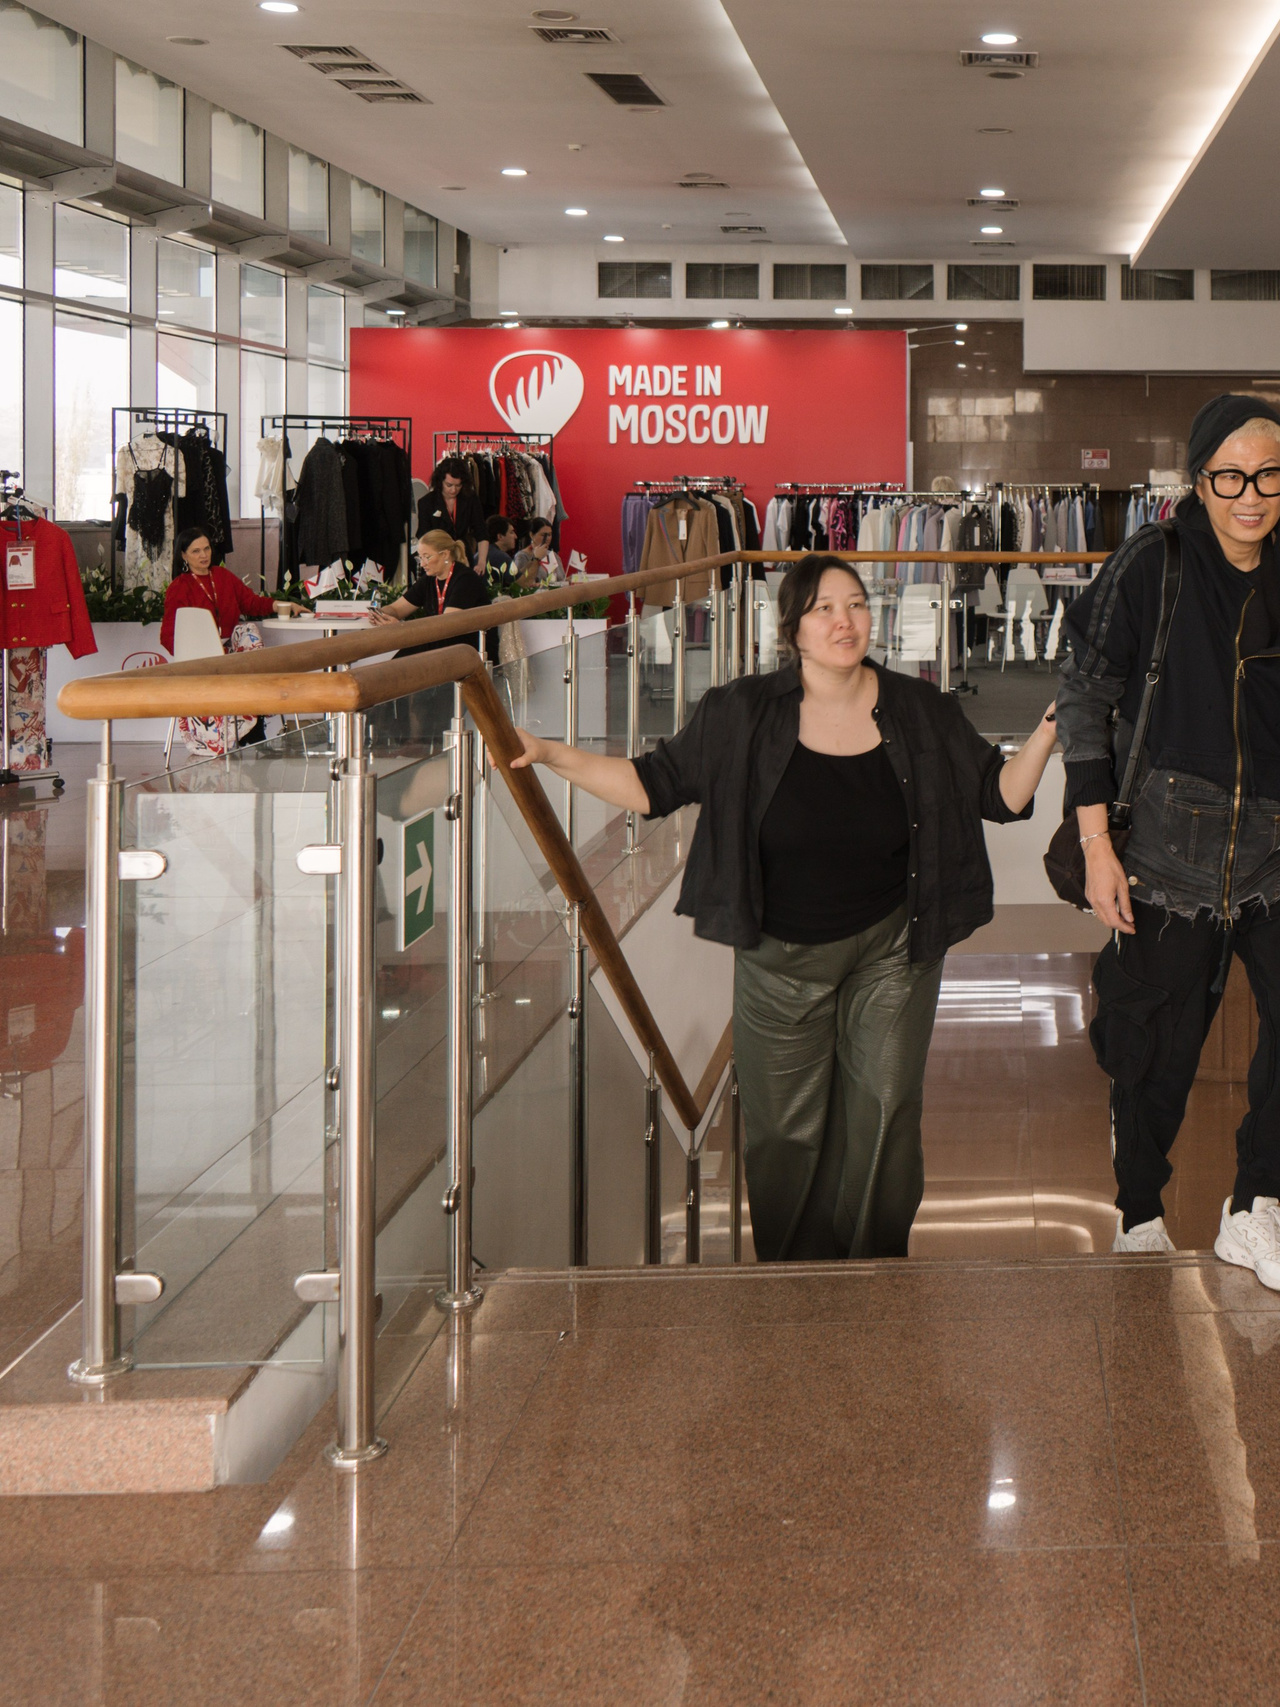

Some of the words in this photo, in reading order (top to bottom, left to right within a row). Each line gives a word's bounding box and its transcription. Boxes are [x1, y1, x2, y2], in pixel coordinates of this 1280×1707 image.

[608, 364, 688, 396] MADE
[695, 365, 722, 396] IN
[608, 404, 769, 445] MOSCOW
